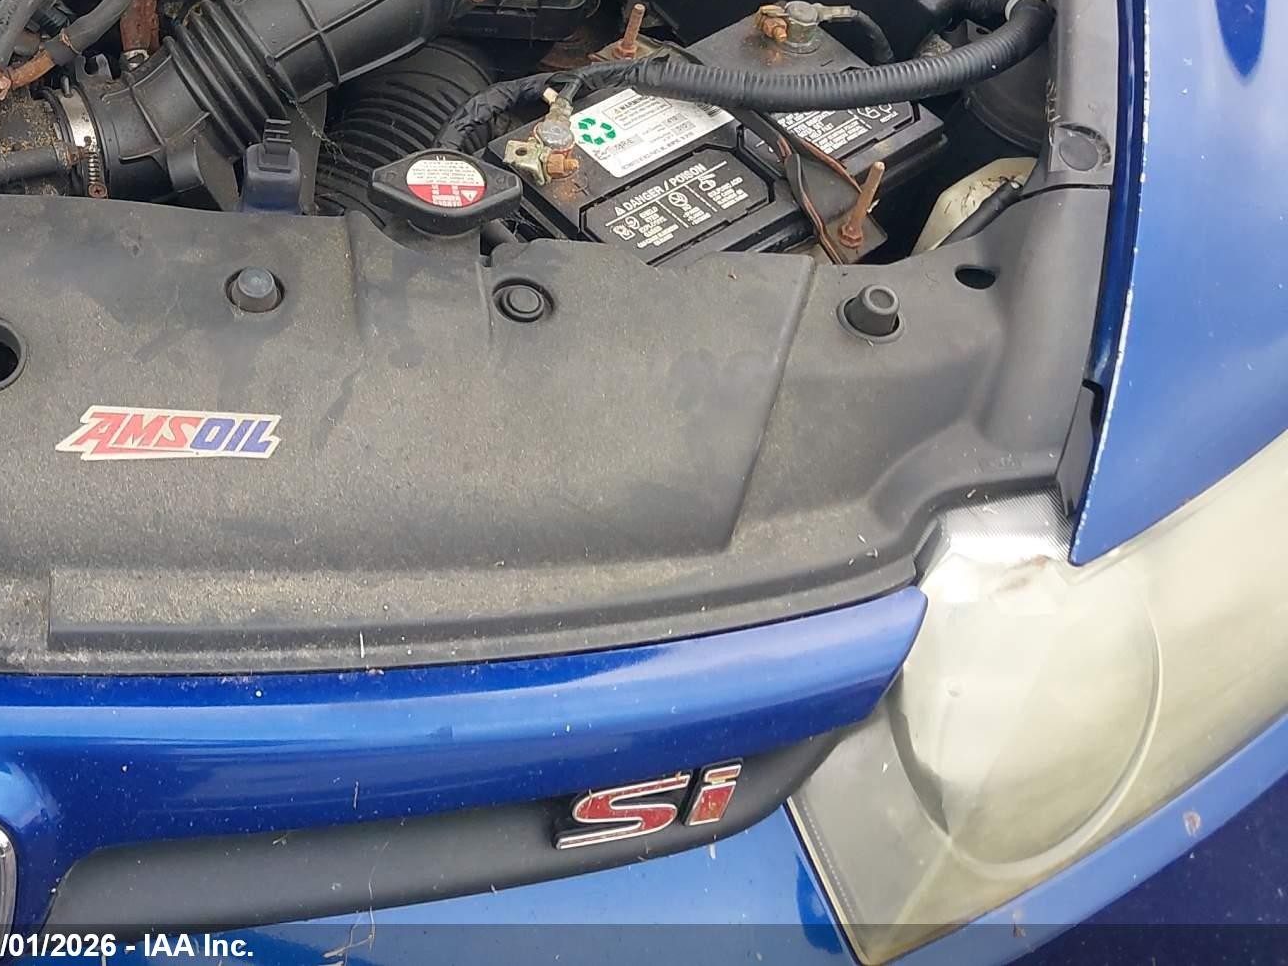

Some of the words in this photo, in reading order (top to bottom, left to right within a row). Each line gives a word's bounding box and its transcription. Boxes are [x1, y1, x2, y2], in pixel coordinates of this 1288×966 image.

[622, 186, 664, 211] DANGER
[669, 163, 707, 187] POISON
[72, 411, 273, 456] AMSOIL
[556, 764, 742, 849] Si
